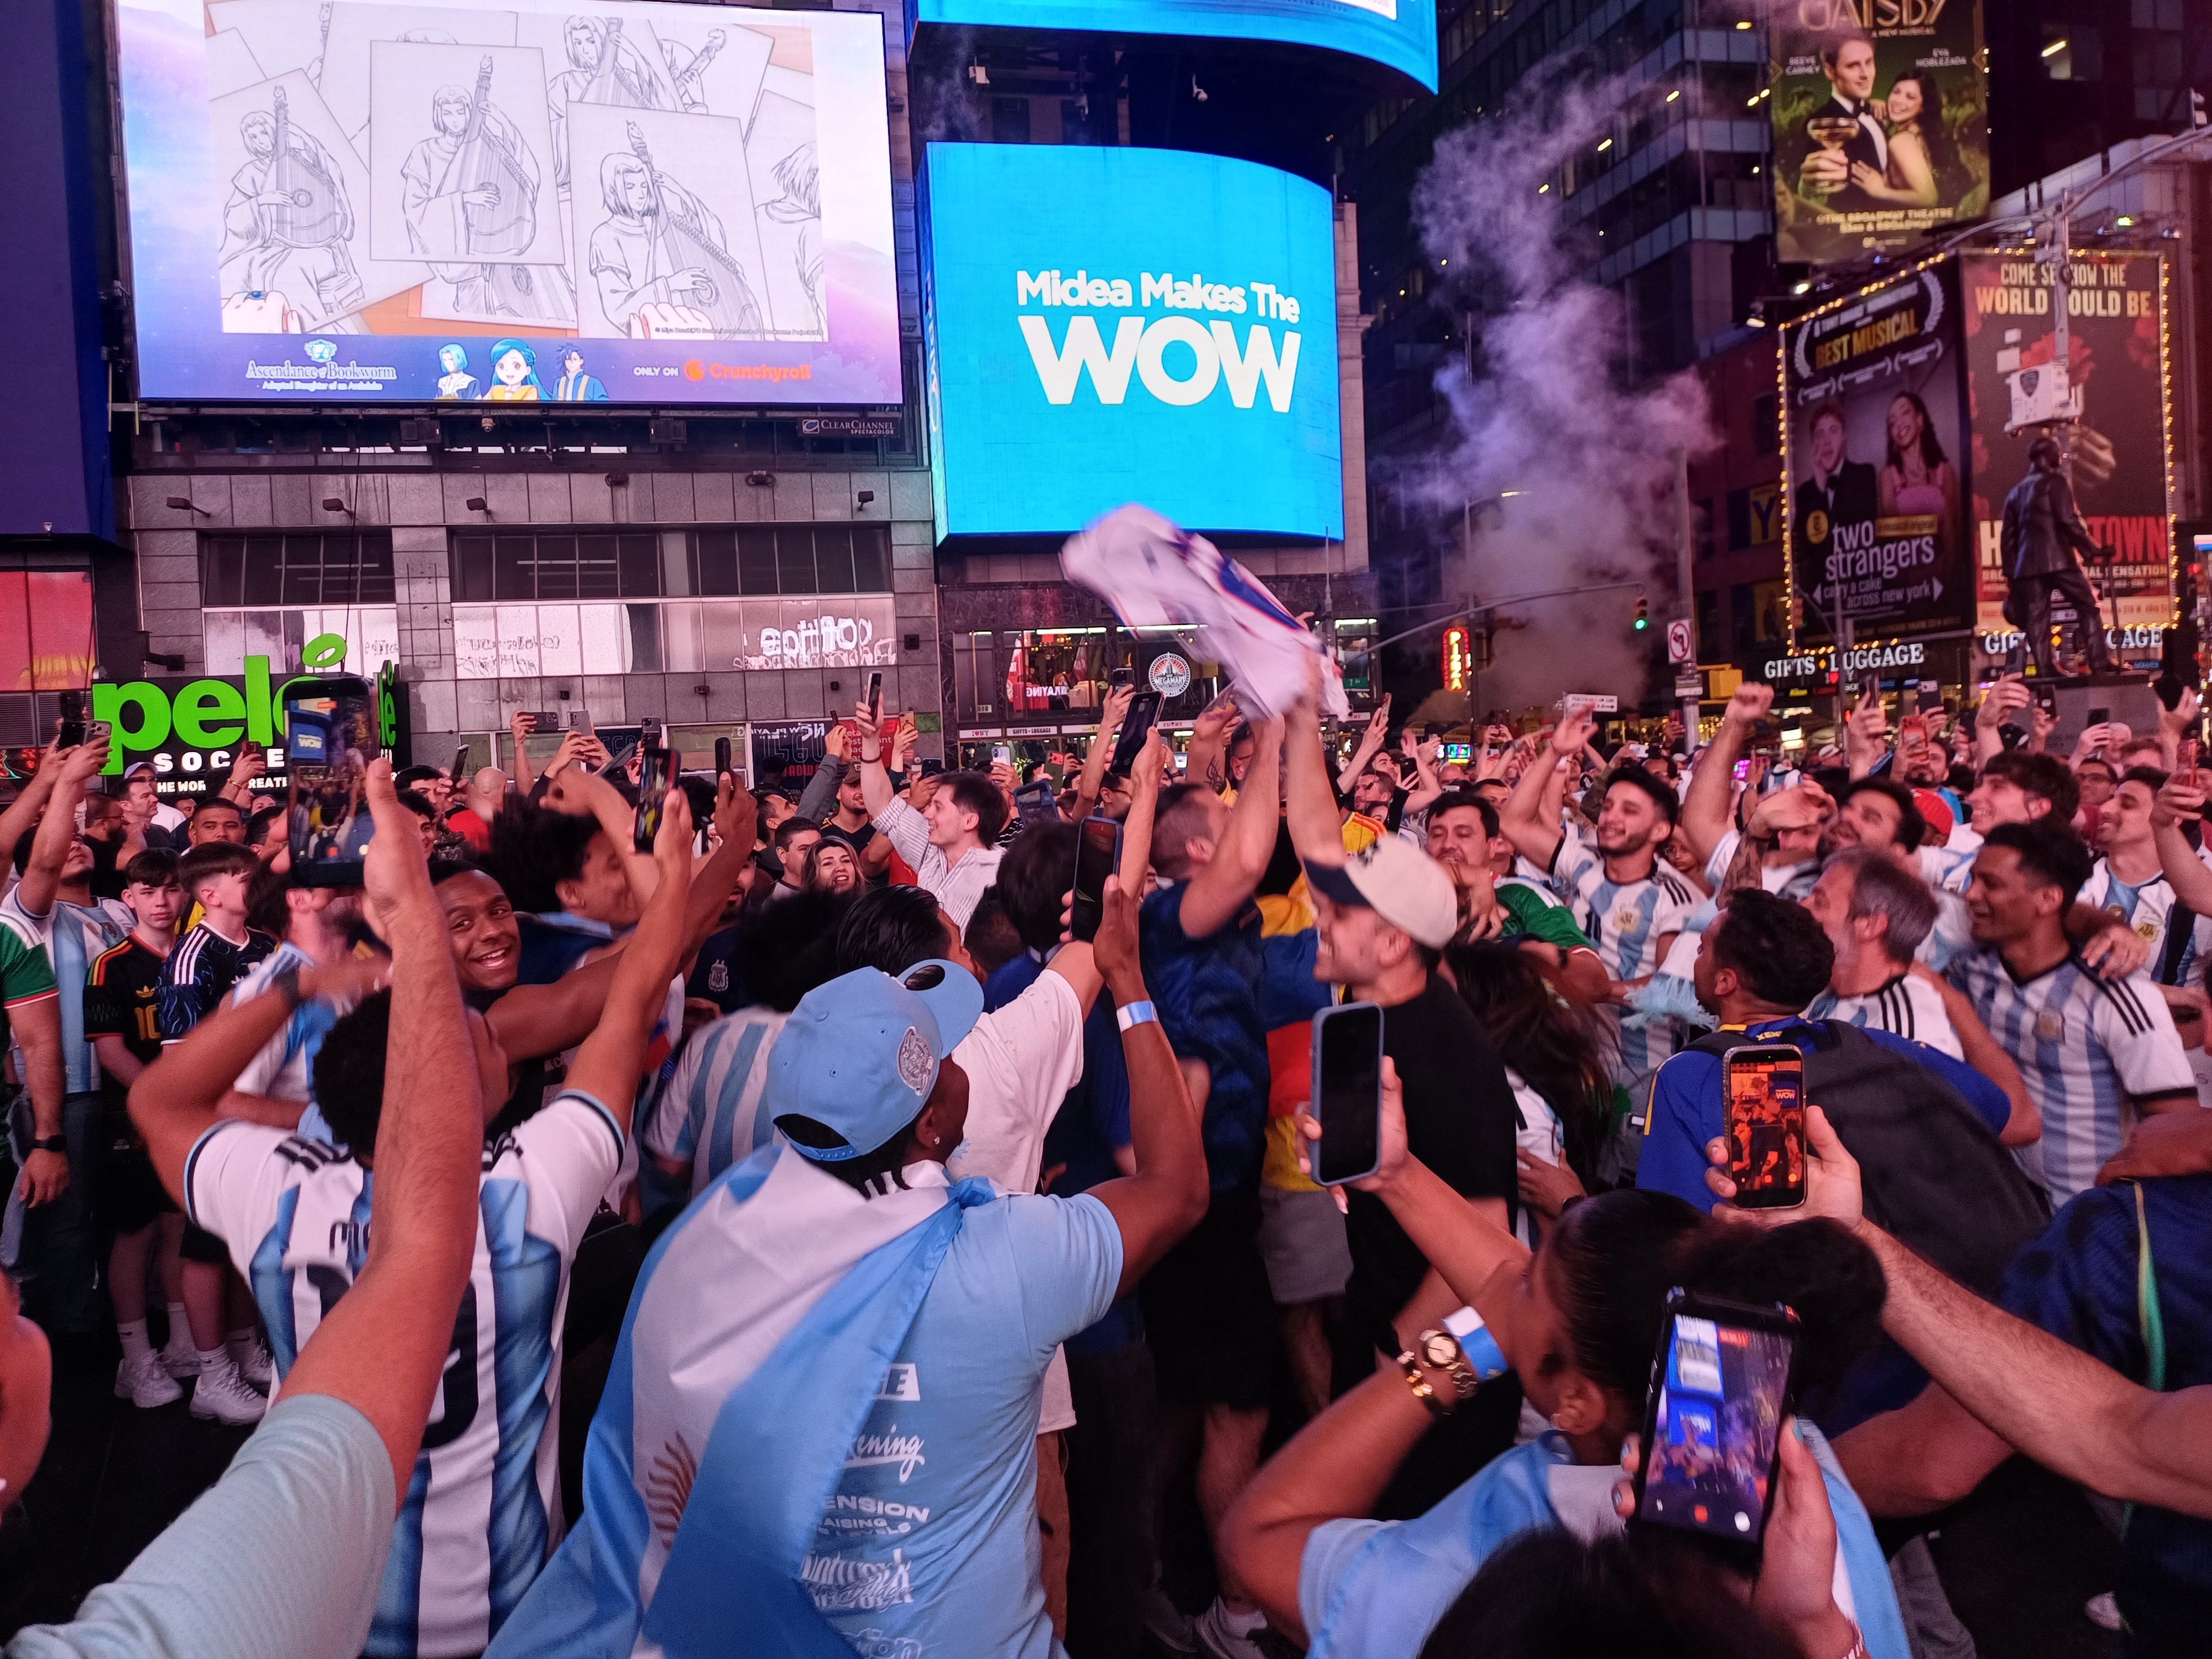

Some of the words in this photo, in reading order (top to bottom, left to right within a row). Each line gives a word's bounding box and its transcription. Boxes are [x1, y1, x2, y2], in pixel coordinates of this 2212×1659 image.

[2000, 262, 2037, 286] COME
[2041, 264, 2056, 286] SE
[2103, 264, 2126, 287] THE
[1016, 269, 1133, 307] Midea
[1140, 272, 1247, 314] Makes
[1250, 281, 1301, 324] The
[1975, 286, 2048, 315] WORLD
[2068, 289, 2121, 317] OULD
[2126, 290, 2152, 317] BE
[1815, 333, 1850, 369] BEST
[1853, 307, 1919, 356] MUSICAL
[249, 359, 317, 377] Ascendance
[328, 361, 395, 378] Bookworm
[634, 366, 660, 376] ONLY
[662, 367, 679, 377] ON
[710, 363, 811, 382] Crunchyroll
[1018, 315, 1302, 413] WOW
[1832, 520, 1874, 551] two
[1825, 535, 1935, 581] strangers
[1448, 631, 1462, 690] PIZZA
[1765, 656, 1815, 679] GIFTS
[1829, 643, 1924, 672] LUGGAGE
[156, 781, 175, 793] HE
[825, 1495, 930, 1522] ENSION
